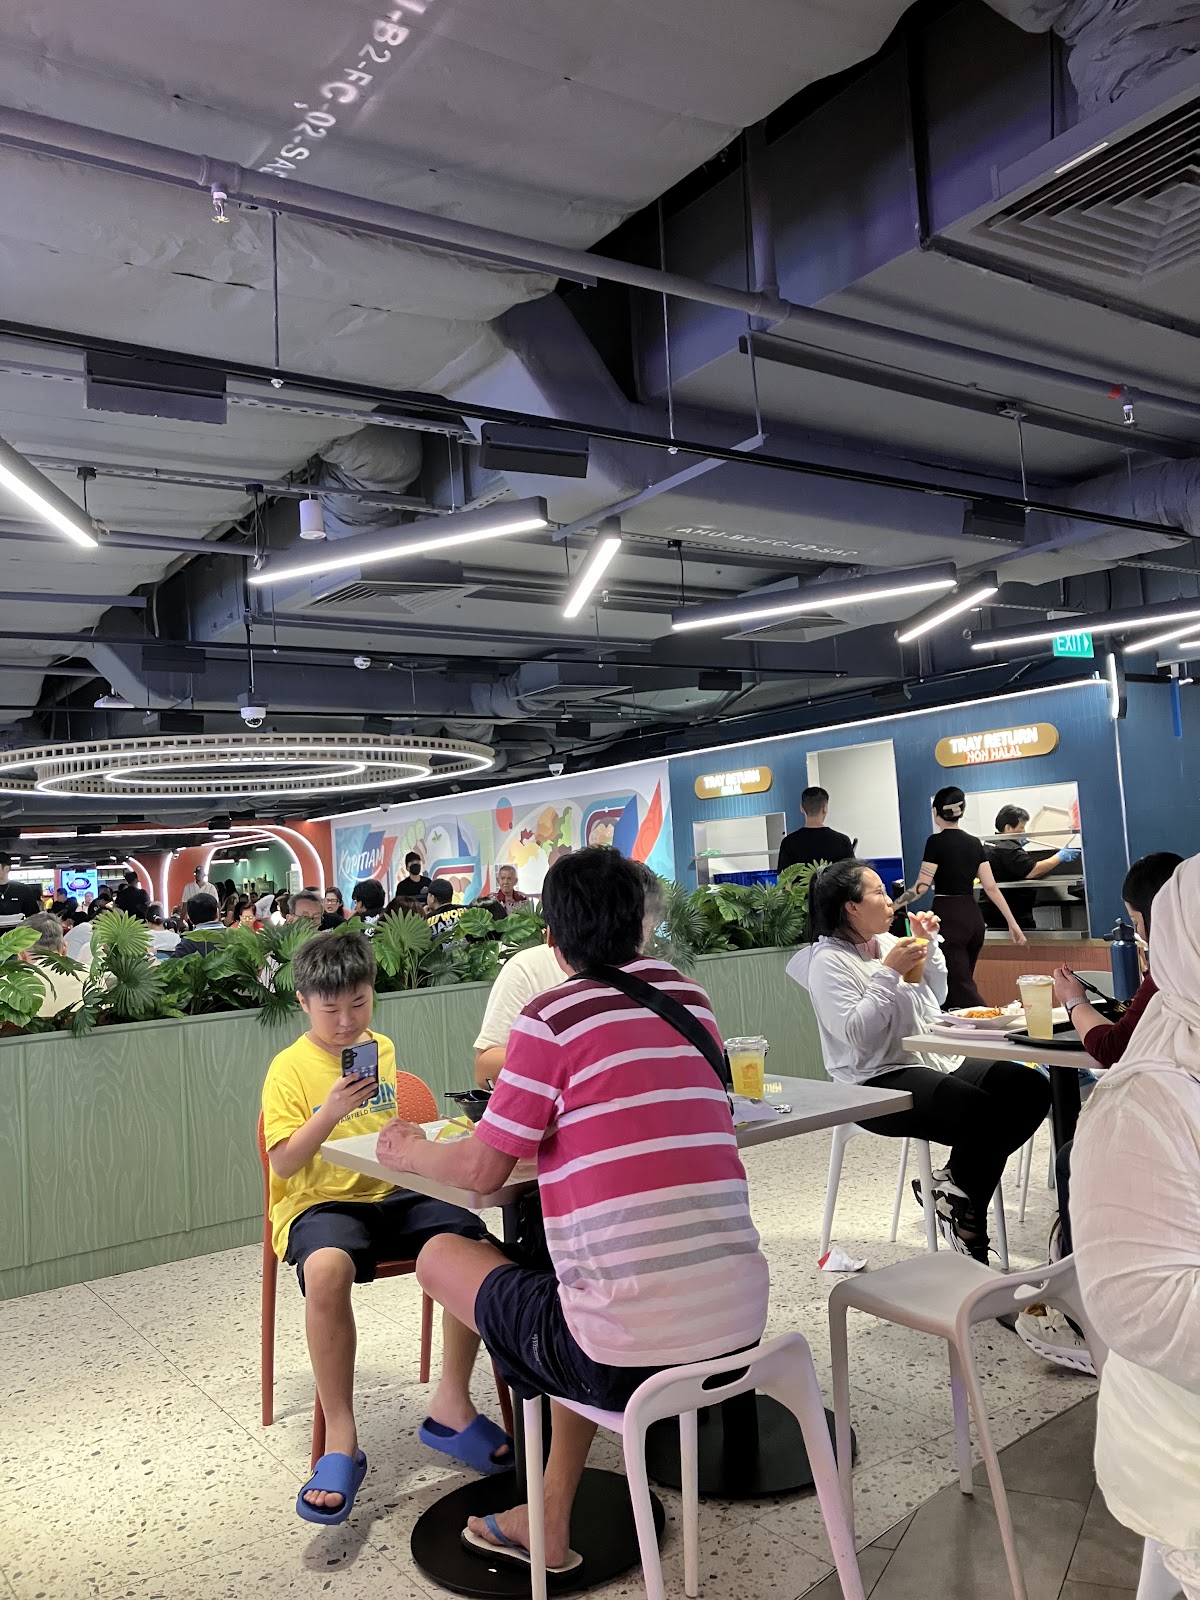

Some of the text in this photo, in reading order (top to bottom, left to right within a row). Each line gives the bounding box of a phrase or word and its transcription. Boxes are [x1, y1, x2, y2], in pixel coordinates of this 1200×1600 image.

[1056, 634, 1082, 652] EXIT
[949, 727, 1039, 754] TRAY RETURN
[966, 745, 1022, 763] NON HALAL
[703, 769, 760, 790] TRAY RETURN
[339, 845, 385, 875] KOPITIAM
[338, 1109, 369, 1125] AIRFIELD
